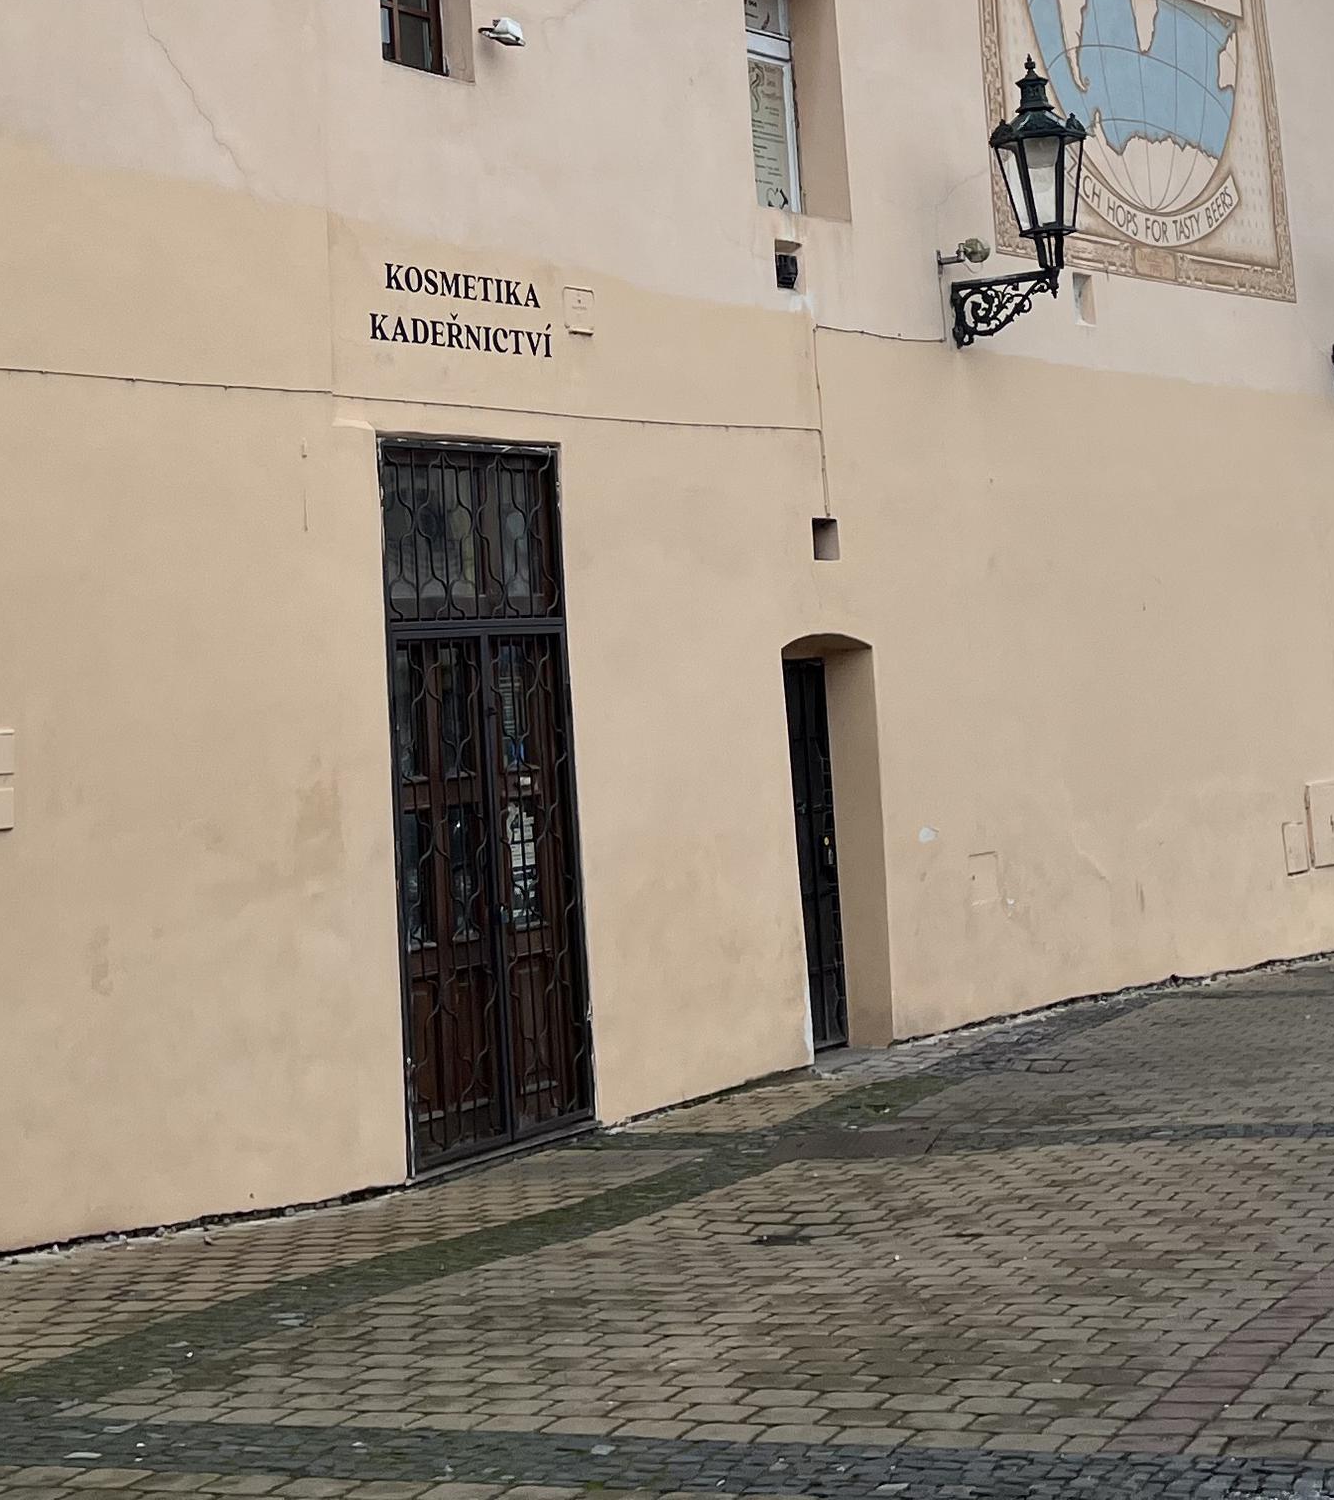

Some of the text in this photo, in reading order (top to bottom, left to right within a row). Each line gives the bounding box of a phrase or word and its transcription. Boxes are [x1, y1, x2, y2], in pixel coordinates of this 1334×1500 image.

[1107, 196, 1139, 237] HOPS
[1145, 217, 1170, 243] FOR
[1172, 211, 1203, 242] TASTY
[1205, 186, 1234, 229] BEERS
[384, 262, 542, 309] KOSMETIKA
[369, 312, 553, 358] KADEŘNICTVÍ
